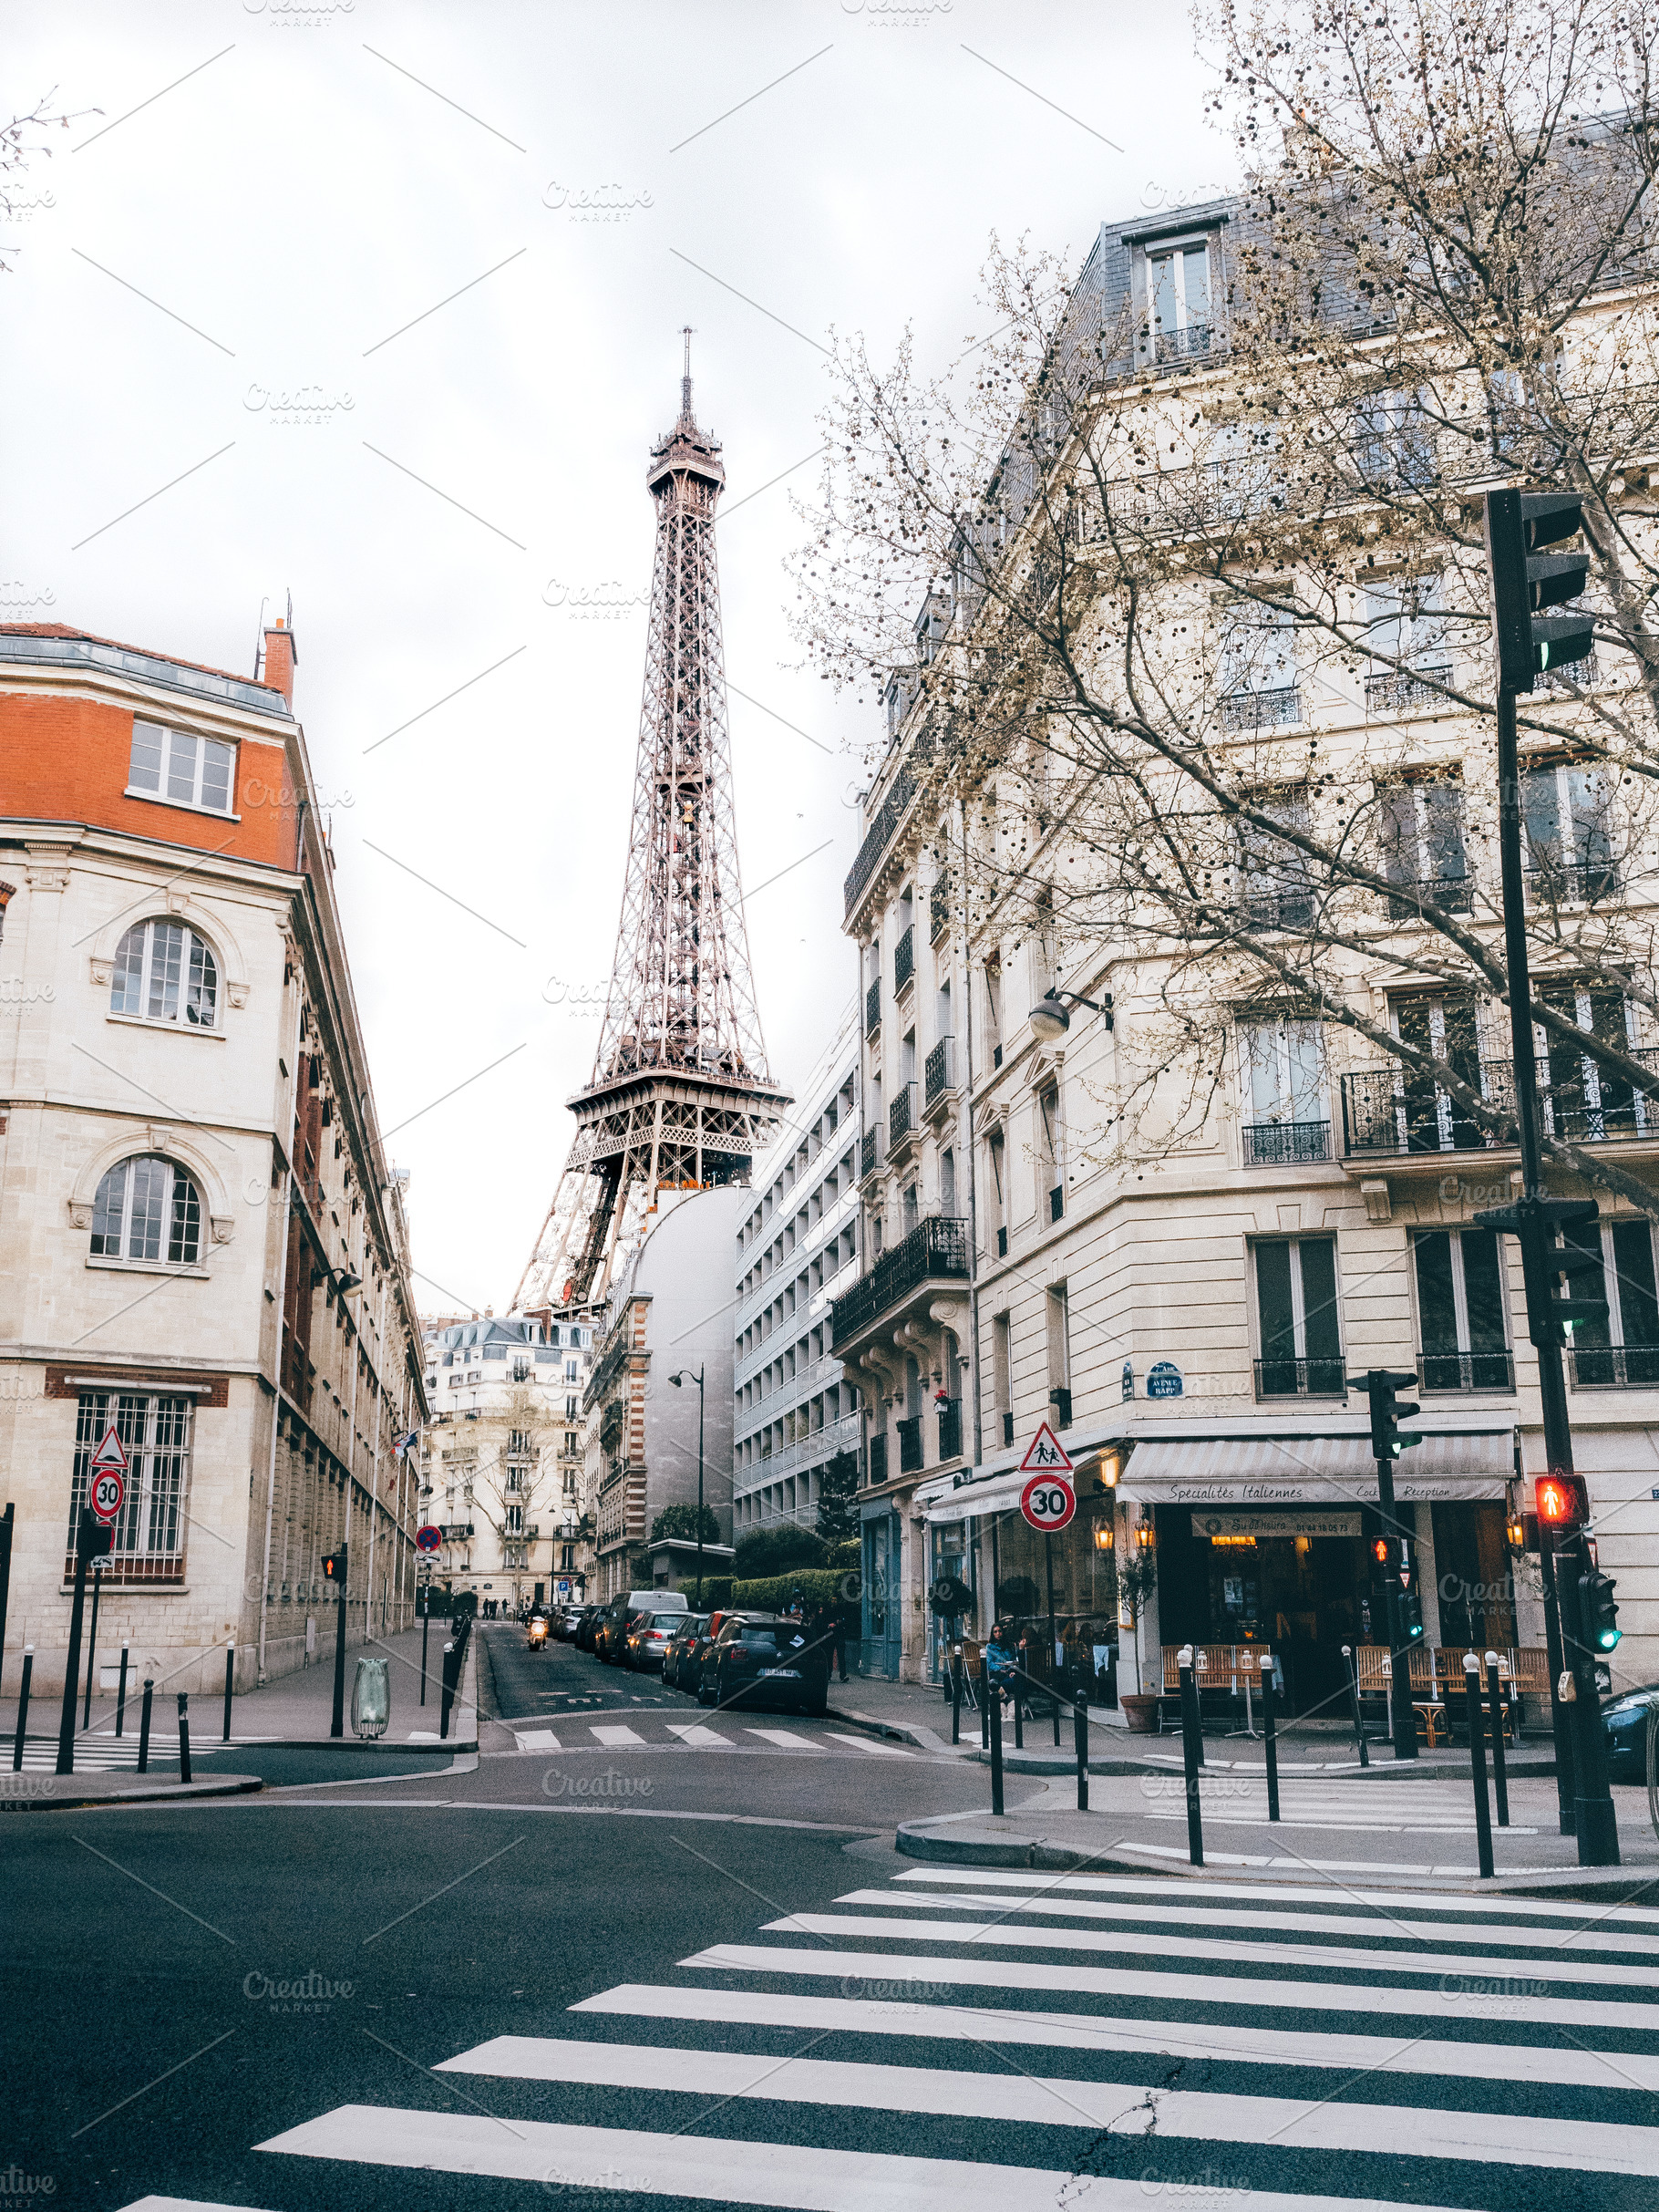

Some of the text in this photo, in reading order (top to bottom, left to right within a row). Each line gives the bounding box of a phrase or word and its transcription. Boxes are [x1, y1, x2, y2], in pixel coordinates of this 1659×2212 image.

[1152, 1379, 1178, 1387] AVENUE
[98, 1482, 118, 1504] 30
[1032, 1489, 1066, 1515] 30
[1169, 1484, 1234, 1502] Spécialités
[1242, 1484, 1303, 1499] Italiennes
[1356, 1485, 1378, 1497] Cock
[1296, 1524, 1304, 1532] 01
[1307, 1524, 1316, 1532] 44
[1318, 1524, 1326, 1532] 18
[1328, 1524, 1337, 1532] 05
[1339, 1524, 1348, 1532] 73
